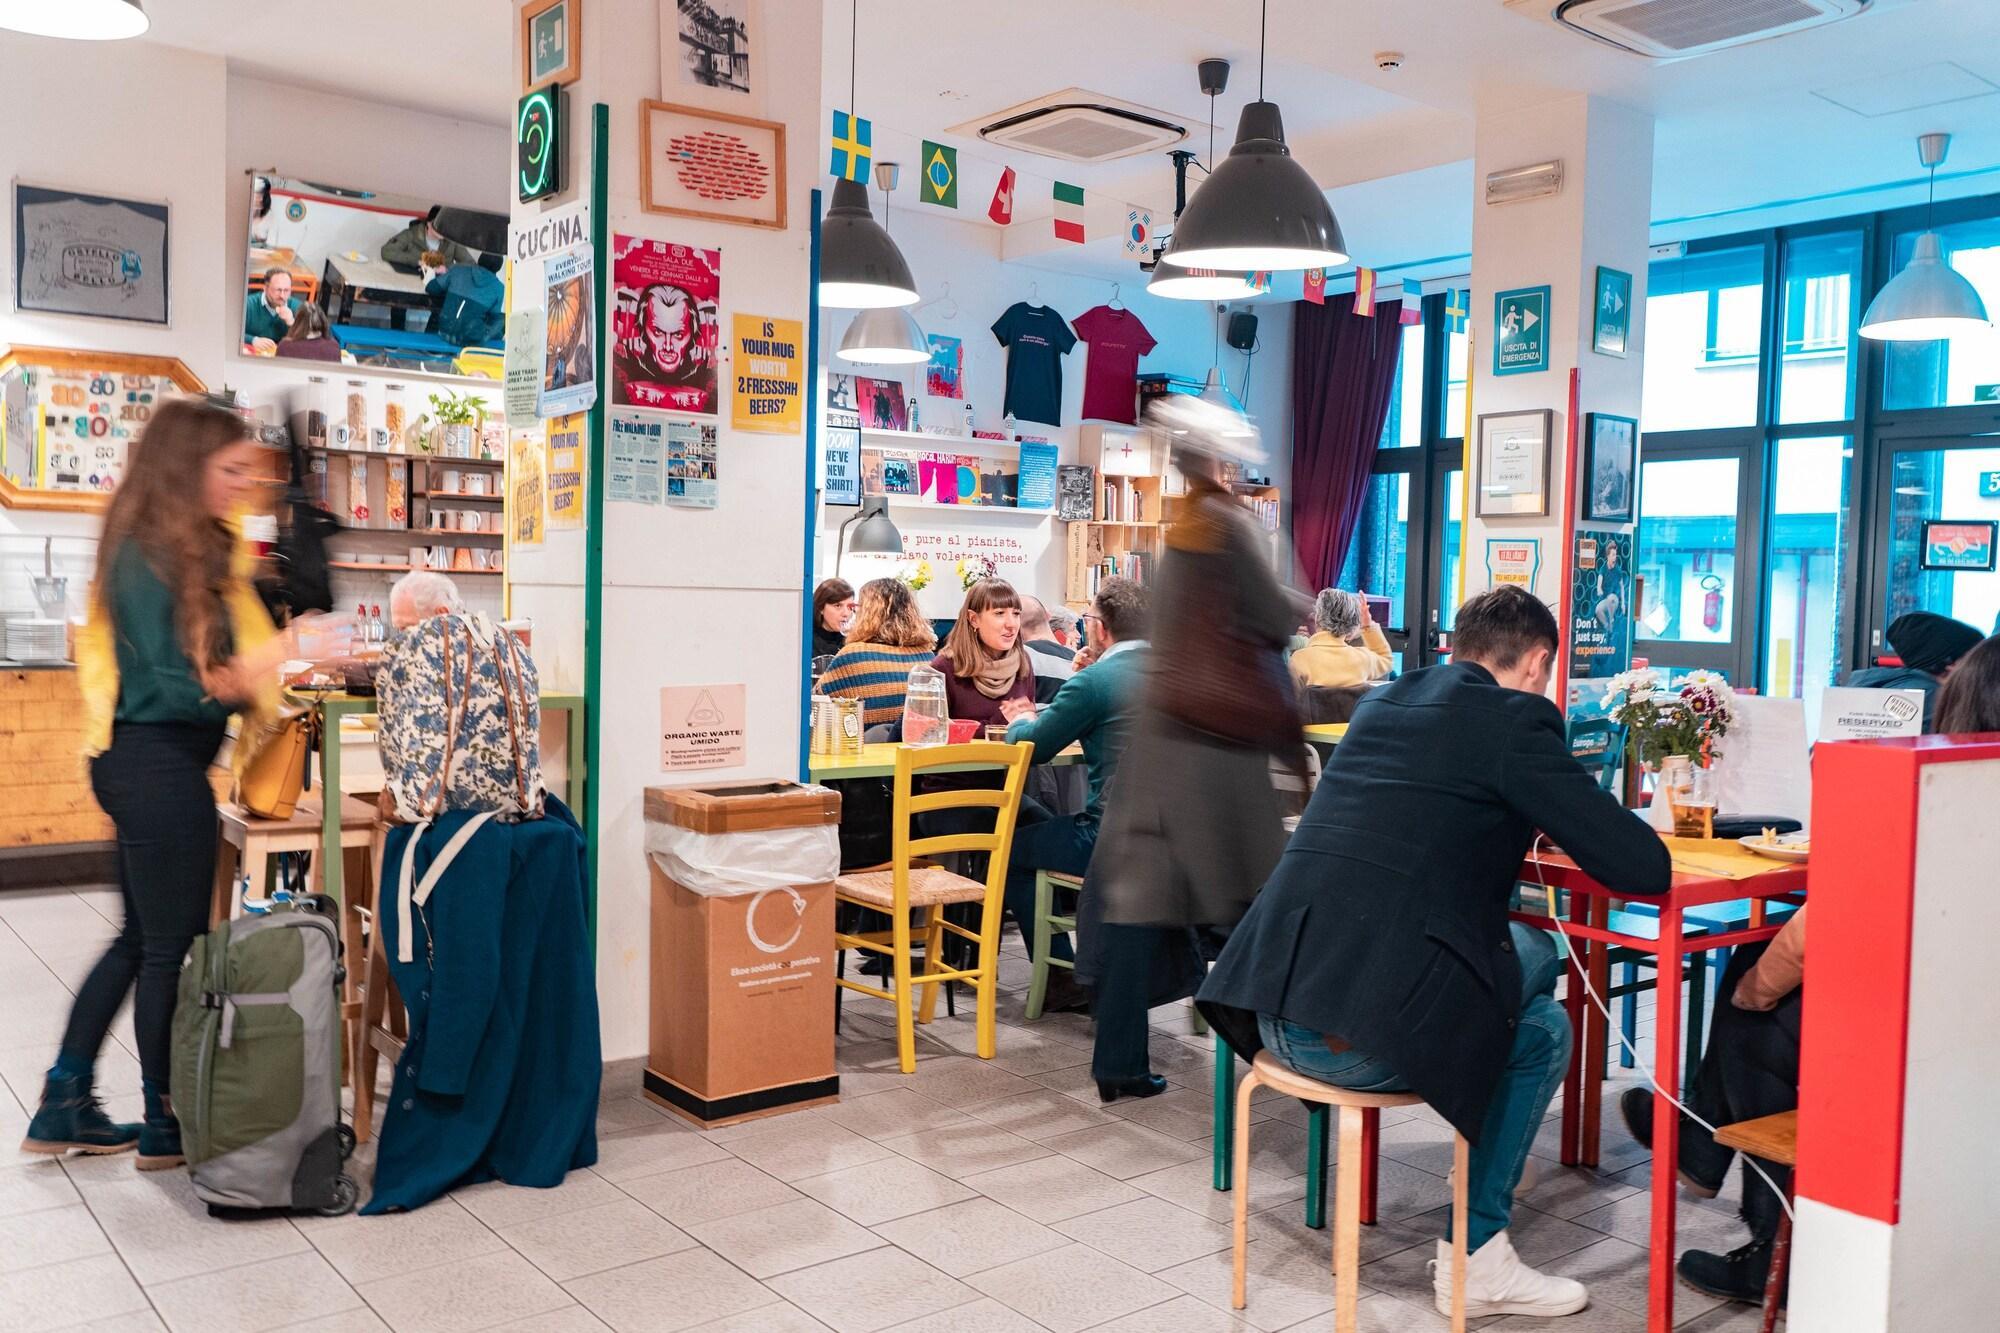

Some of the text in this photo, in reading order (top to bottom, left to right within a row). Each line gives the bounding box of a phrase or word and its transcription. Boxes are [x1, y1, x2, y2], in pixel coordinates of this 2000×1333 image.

[518, 214, 582, 260] CUCINA
[663, 256, 679, 264] SALA
[548, 259, 592, 282] WALKING TOUR
[763, 322, 774, 338] IS
[742, 338, 795, 360] YOUR MUG
[1504, 342, 1537, 352] USCITA DI
[1502, 353, 1540, 363] EMERGENZA
[750, 359, 787, 377] WORTH
[89, 378, 115, 396] 80
[738, 376, 798, 396] 2 FRESSSHH
[750, 399, 786, 415] BEERS?
[562, 414, 569, 429] IS
[551, 431, 579, 449] YOUR MUG
[828, 464, 845, 476] NEW
[554, 491, 574, 511] BEERS?
[916, 536, 942, 546] pure
[948, 535, 960, 545] al
[968, 536, 1022, 549] pianista,
[896, 550, 928, 561] piano
[993, 552, 1028, 564] bbene!
[1576, 618, 1597, 629] Don't
[1575, 632, 1606, 644] just say,
[1576, 646, 1616, 658] experience
[1838, 718, 1903, 727] RESERVED
[664, 729, 743, 740] ORGANIC WASTE/
